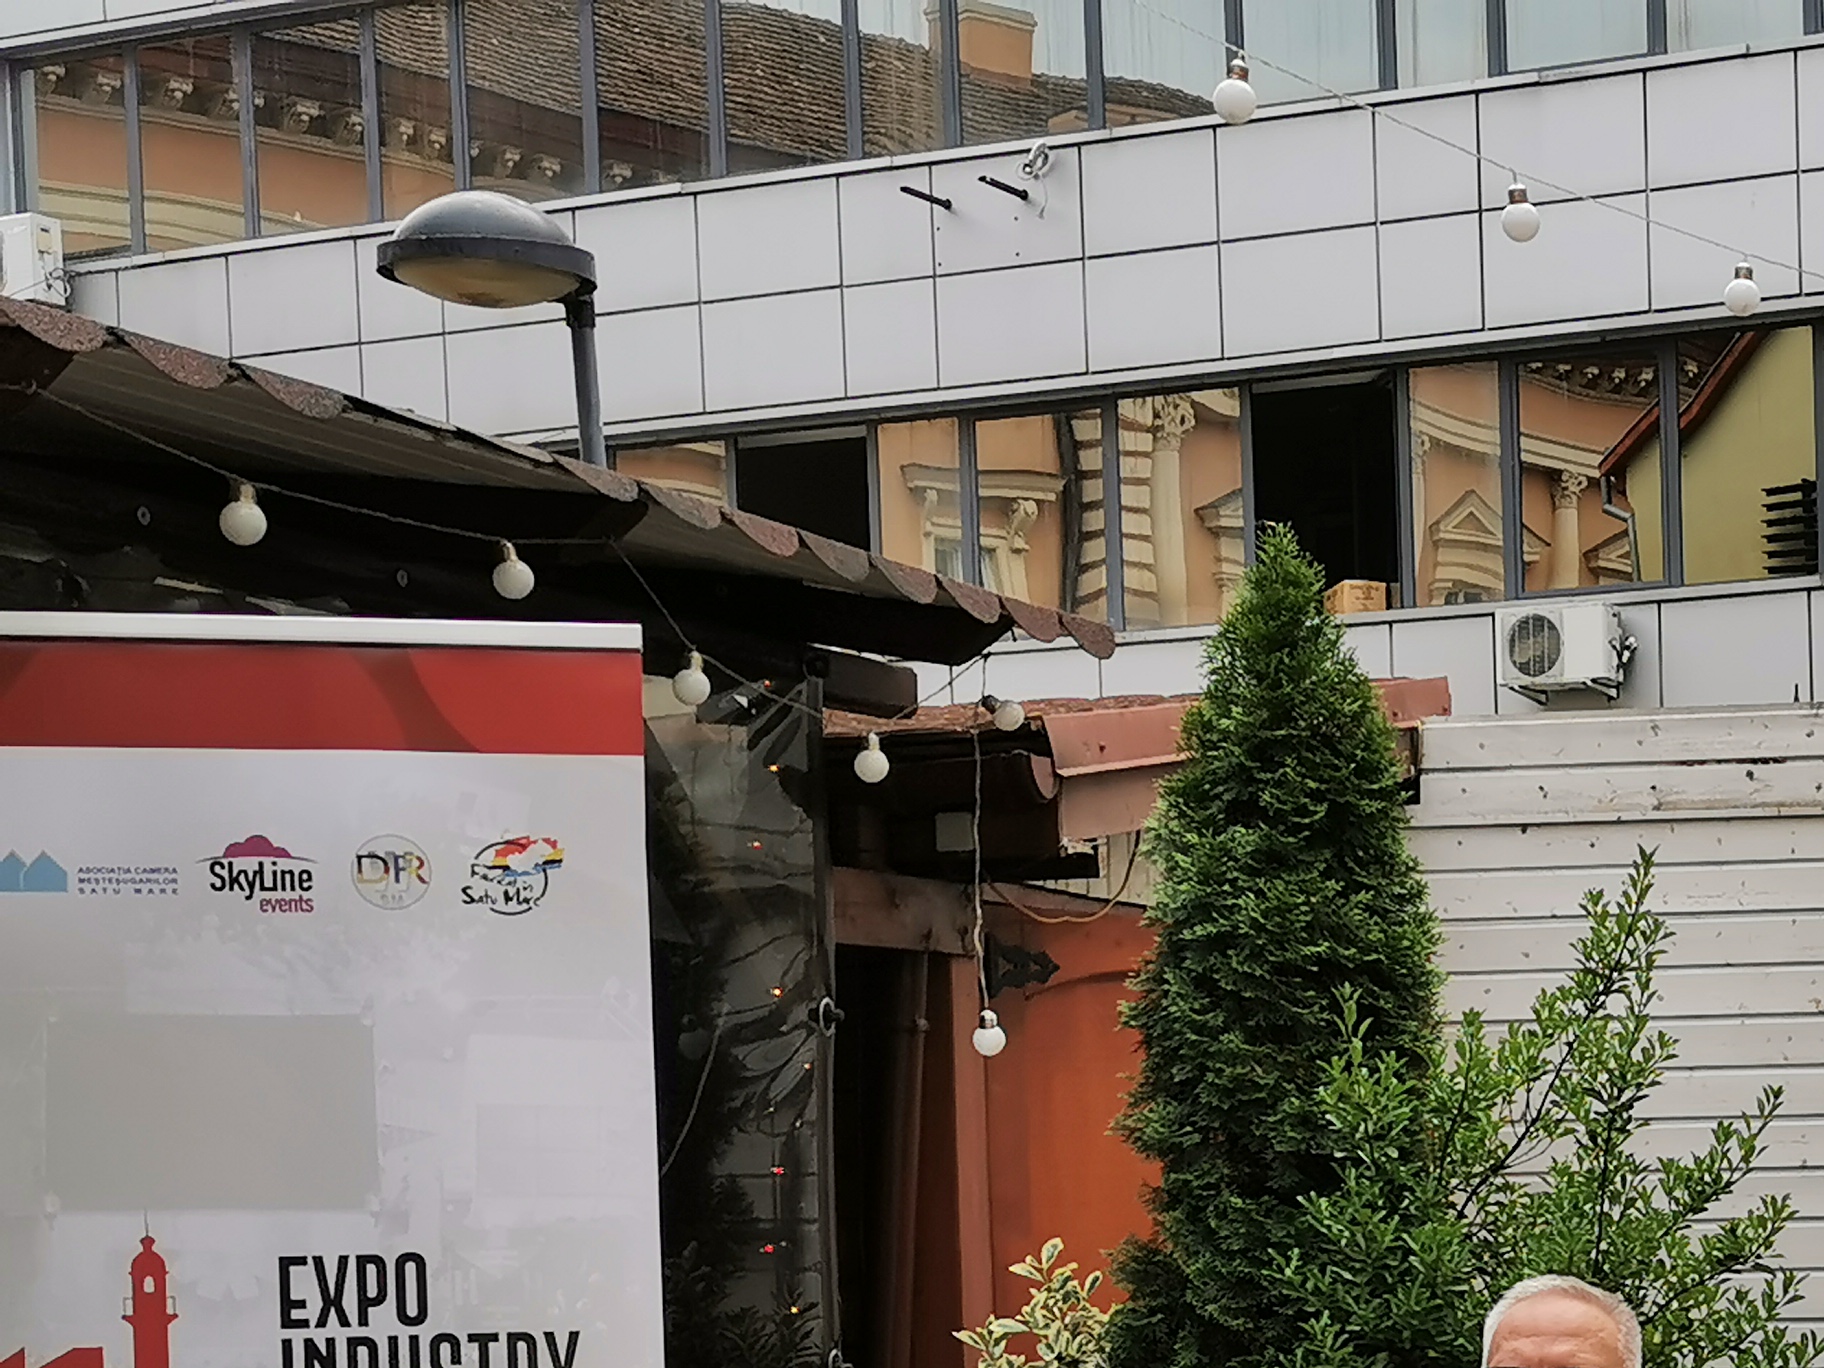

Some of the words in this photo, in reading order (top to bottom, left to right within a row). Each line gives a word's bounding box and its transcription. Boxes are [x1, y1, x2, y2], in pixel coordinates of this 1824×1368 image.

[134, 866, 178, 875] CAMERA
[209, 860, 313, 901] SkyLine
[78, 887, 121, 896] SATU
[259, 894, 315, 913] events
[278, 1251, 429, 1330] EXPO
